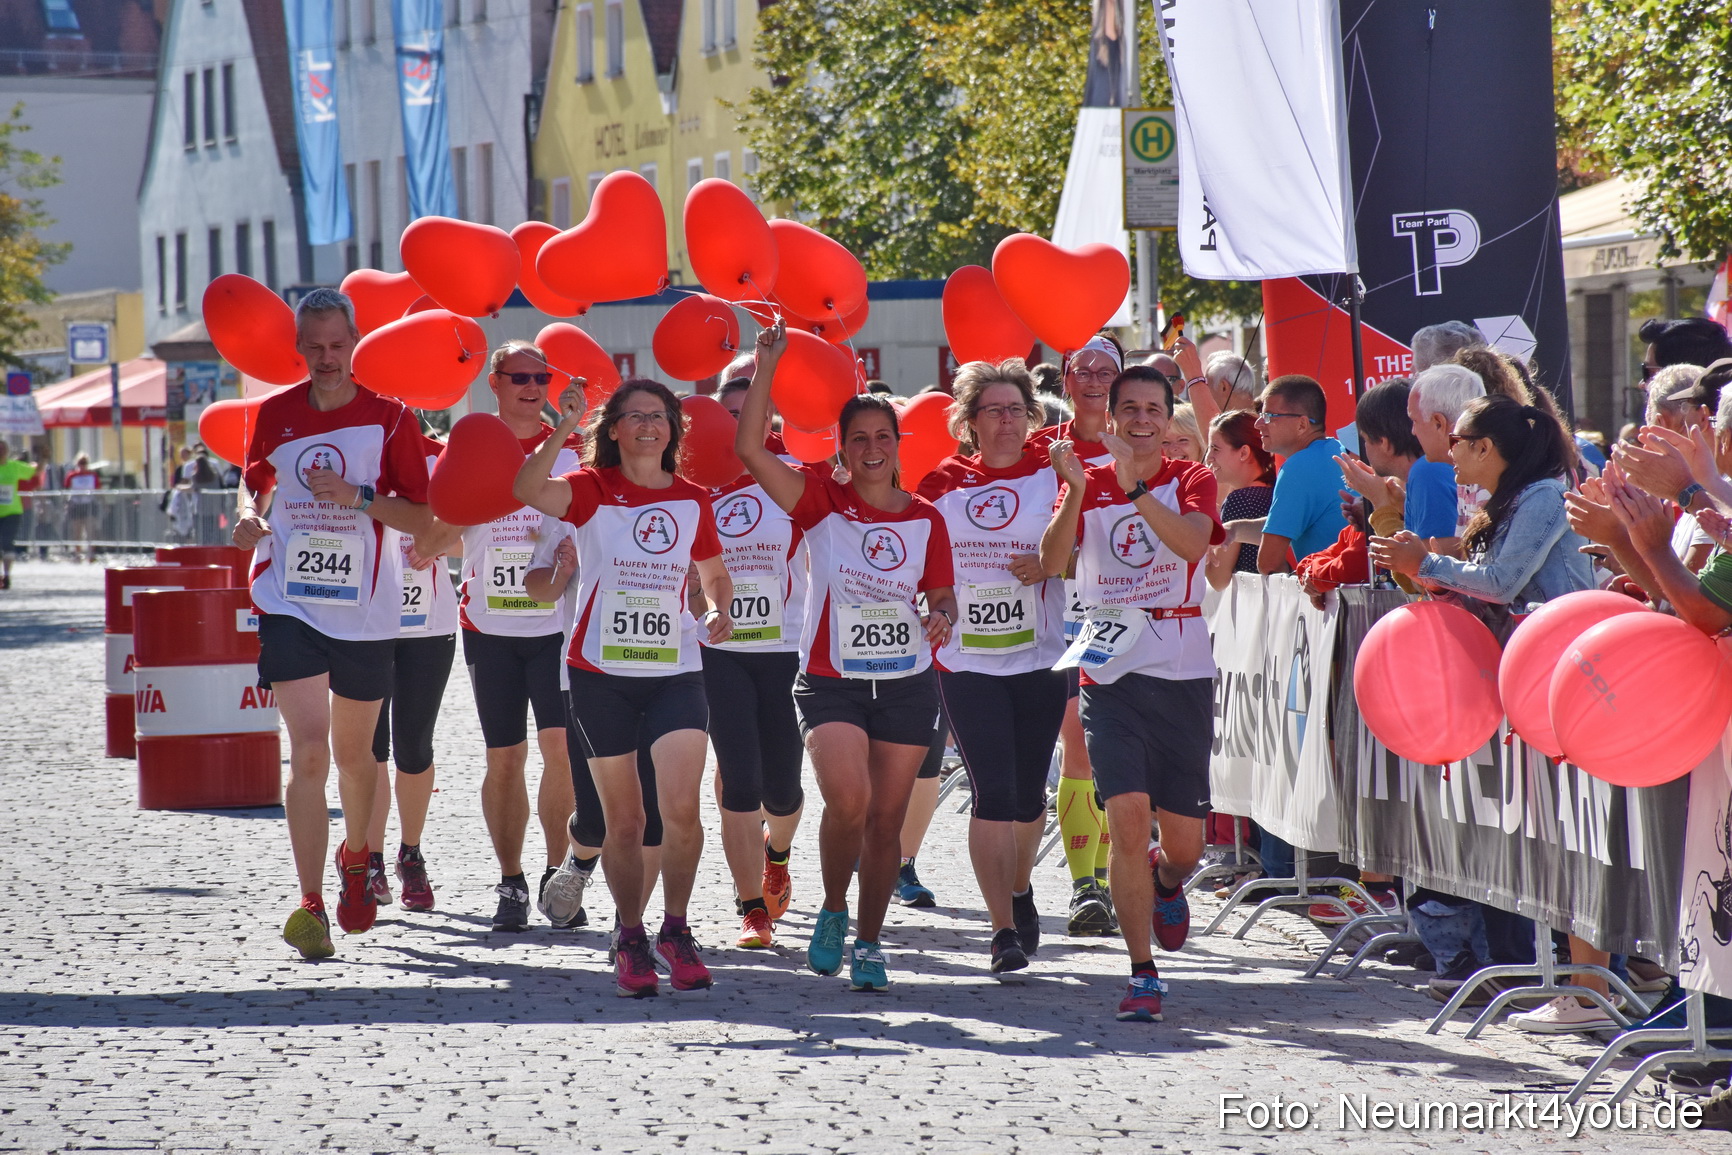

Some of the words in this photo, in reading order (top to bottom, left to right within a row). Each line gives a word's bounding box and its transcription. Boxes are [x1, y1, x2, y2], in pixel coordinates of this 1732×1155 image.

[1134, 168, 1172, 176] Marktplatz
[1374, 354, 1412, 373] THE
[318, 502, 335, 510] MIT
[309, 537, 343, 548] BOCK
[757, 543, 781, 551] HERZ
[1011, 541, 1036, 550] HERZ
[297, 550, 351, 576] 2344
[614, 557, 647, 568] LAUFEN
[651, 562, 667, 570] MIT
[960, 562, 1008, 571] Leistungsdiag
[840, 564, 873, 581] LAUFEN
[876, 578, 893, 587] MIT
[897, 581, 913, 594] HERZ
[1098, 575, 1132, 585] LAUFEN
[1152, 563, 1177, 575] HERZ
[1145, 578, 1170, 588] Röschl
[304, 585, 340, 598] Rüdiger
[403, 586, 422, 606] 52
[977, 588, 1012, 597] BOCK
[1101, 587, 1170, 604] Leistungsdiagnostik
[503, 600, 538, 608] Andreas
[626, 597, 660, 606] BOCK
[730, 596, 770, 618] 070
[862, 609, 898, 617] BOCK
[969, 600, 1024, 625] 5204
[613, 612, 670, 636] 5166
[851, 623, 910, 647] 2638
[623, 649, 658, 660] Claudia
[866, 661, 898, 671] Sevinc
